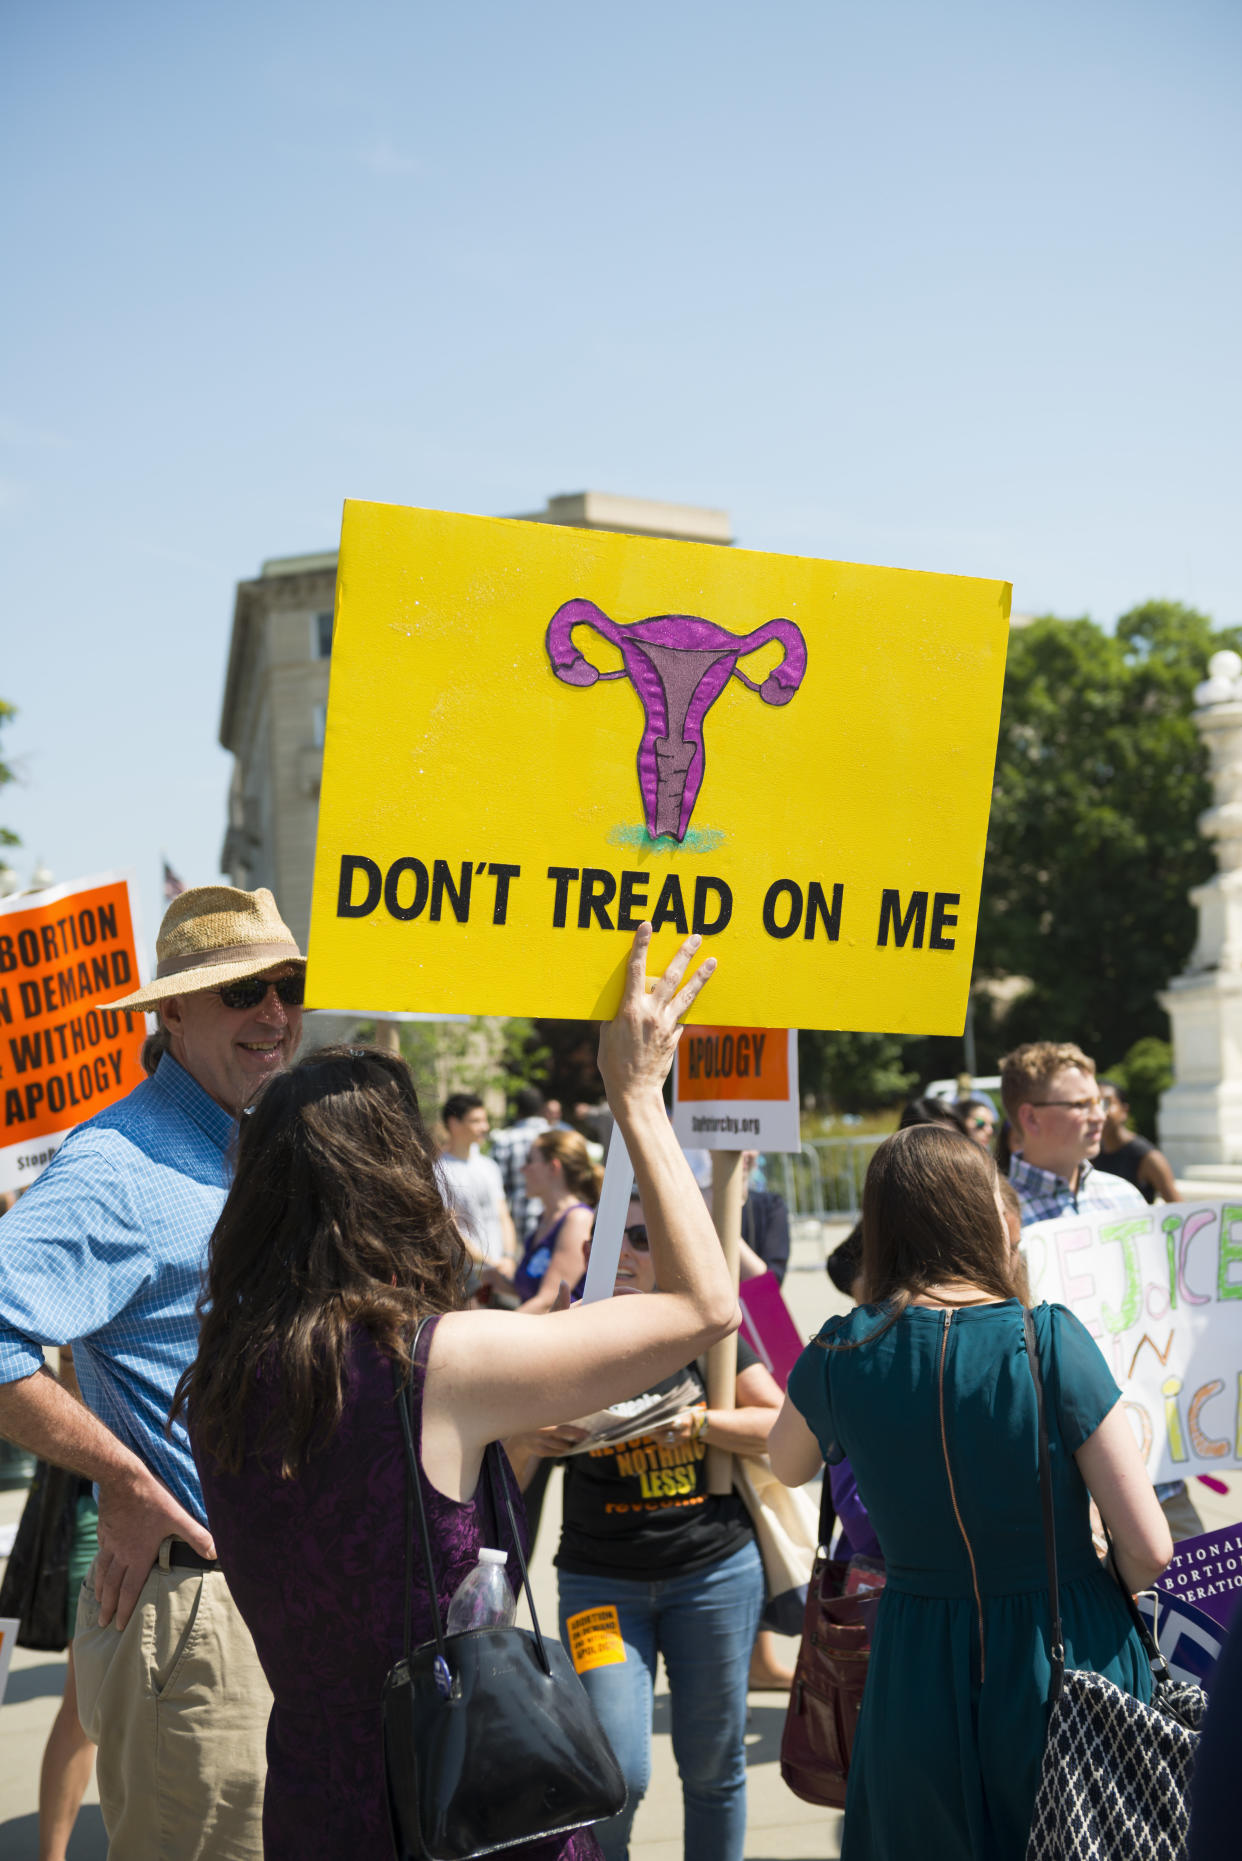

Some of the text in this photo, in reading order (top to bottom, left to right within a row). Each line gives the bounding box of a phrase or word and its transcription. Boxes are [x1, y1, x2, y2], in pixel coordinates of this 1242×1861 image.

[336, 854, 960, 950] DON'T TREAD ON ME
[19, 949, 133, 1019] DEMAND
[8, 1008, 135, 1075] WITHOUT
[688, 1033, 766, 1079] APOLOGY
[4, 1048, 123, 1127] APOLOGY
[639, 1464, 697, 1499] LESS!
[1153, 1556, 1242, 1590] BORTIO
[1164, 1537, 1242, 1571] TIONAL
